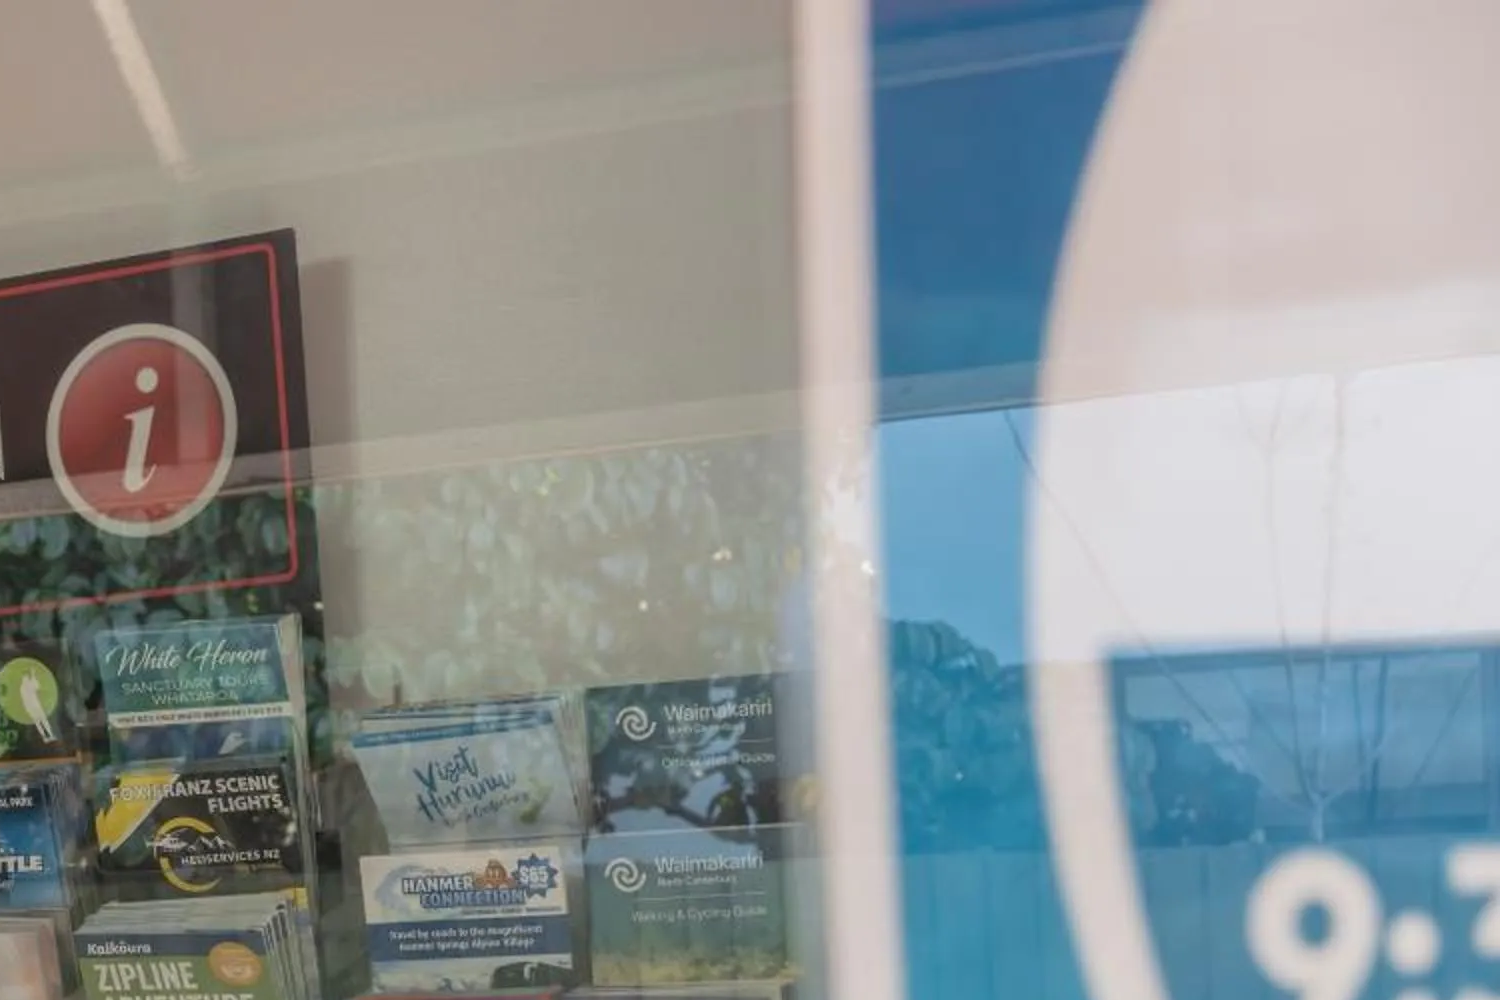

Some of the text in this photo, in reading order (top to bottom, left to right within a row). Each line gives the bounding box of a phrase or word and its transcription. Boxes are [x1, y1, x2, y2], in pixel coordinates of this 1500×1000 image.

[106, 639, 269, 677] White Heron
[663, 698, 773, 722] Waimakariri
[413, 745, 479, 793] Visit
[215, 774, 280, 794] SCENIC
[207, 794, 284, 814] FLIGHTS
[655, 852, 764, 873] Waimakariri
[404, 875, 475, 893] HANMER
[420, 888, 527, 909] CONNECTION
[94, 962, 198, 991] ZIPLINE
